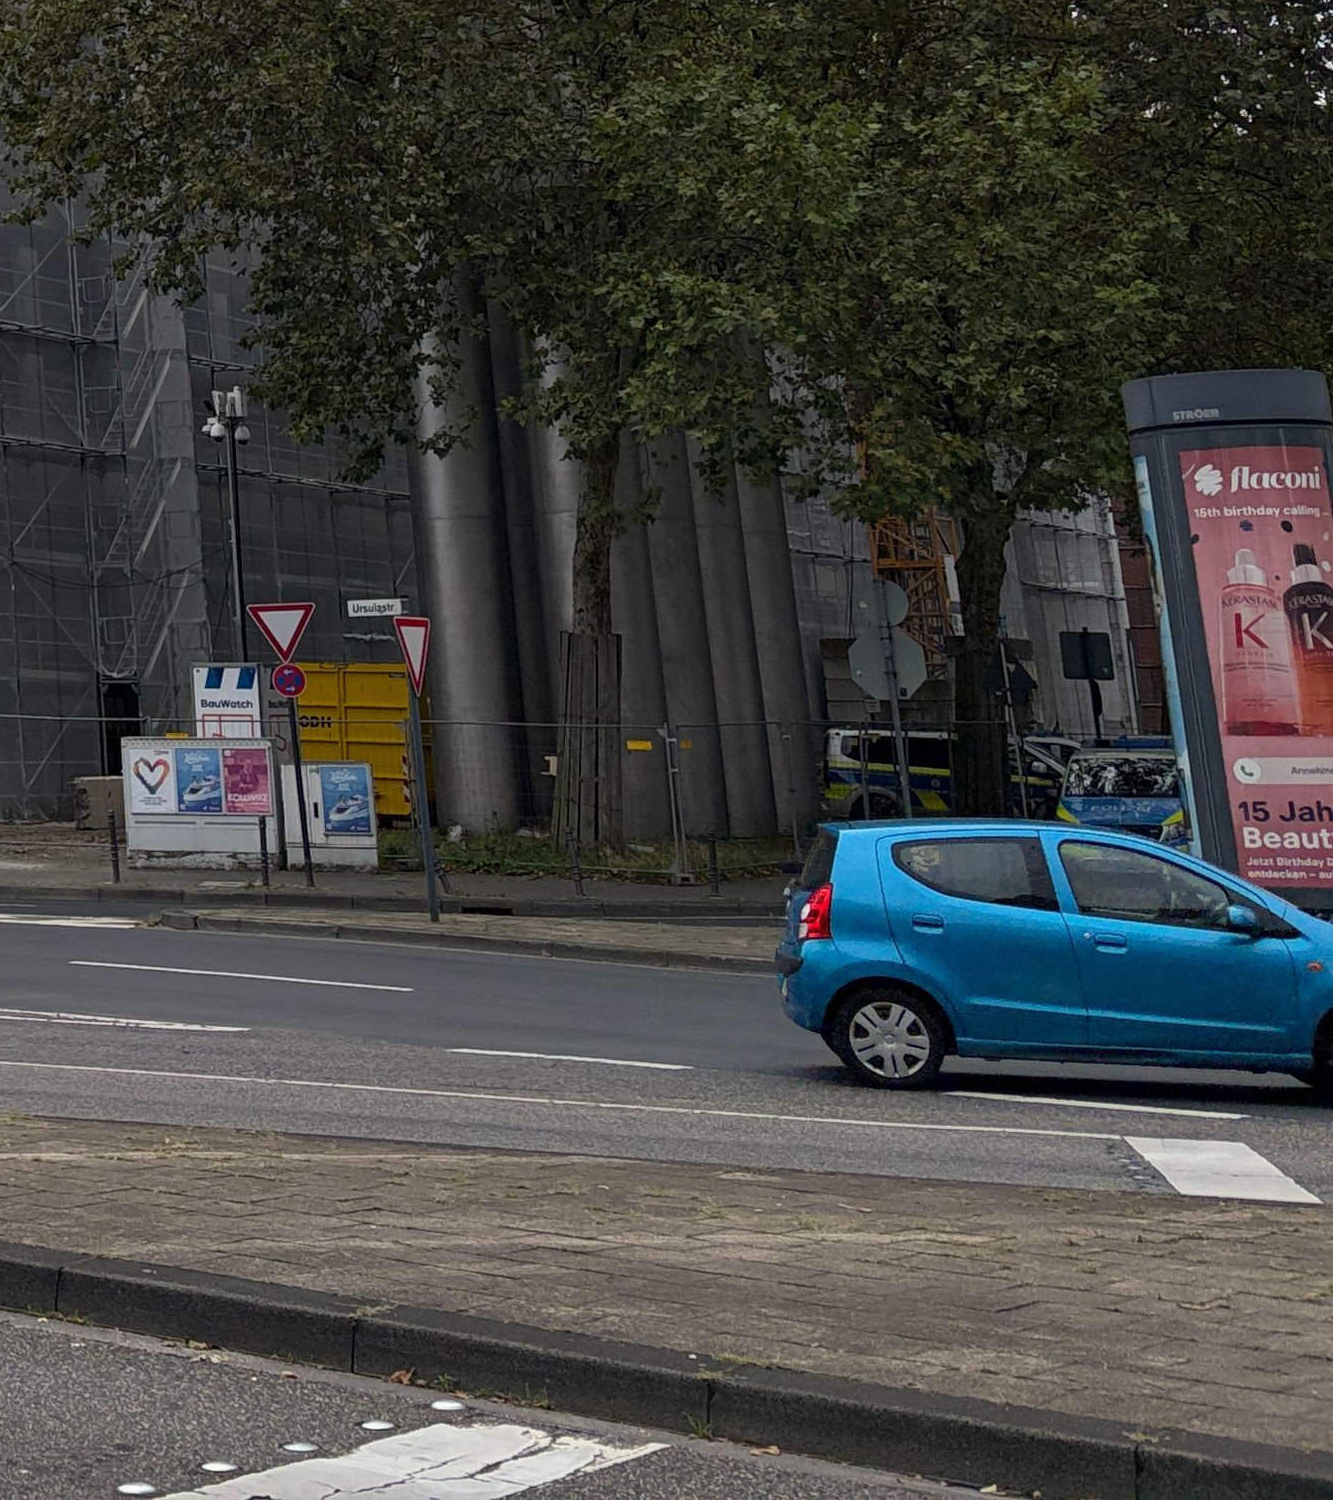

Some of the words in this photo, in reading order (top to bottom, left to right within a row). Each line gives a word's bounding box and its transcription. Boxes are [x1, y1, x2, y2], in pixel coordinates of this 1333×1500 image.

[1173, 408, 1220, 421] STRÖER
[1230, 465, 1321, 493] flaconi
[1194, 508, 1220, 518] 15th
[1224, 505, 1281, 517] birthday
[1235, 612, 1269, 649] K
[1302, 611, 1333, 650] K
[201, 699, 253, 709] BauWatch
[227, 793, 268, 802] KOLLWITZ
[1238, 801, 1270, 822] 15
[1243, 826, 1333, 850] Beaut
[1247, 856, 1274, 867] Jetzt
[1276, 857, 1325, 869] Birthday
[1248, 870, 1307, 879] entdecken
[1318, 871, 1333, 879] au
